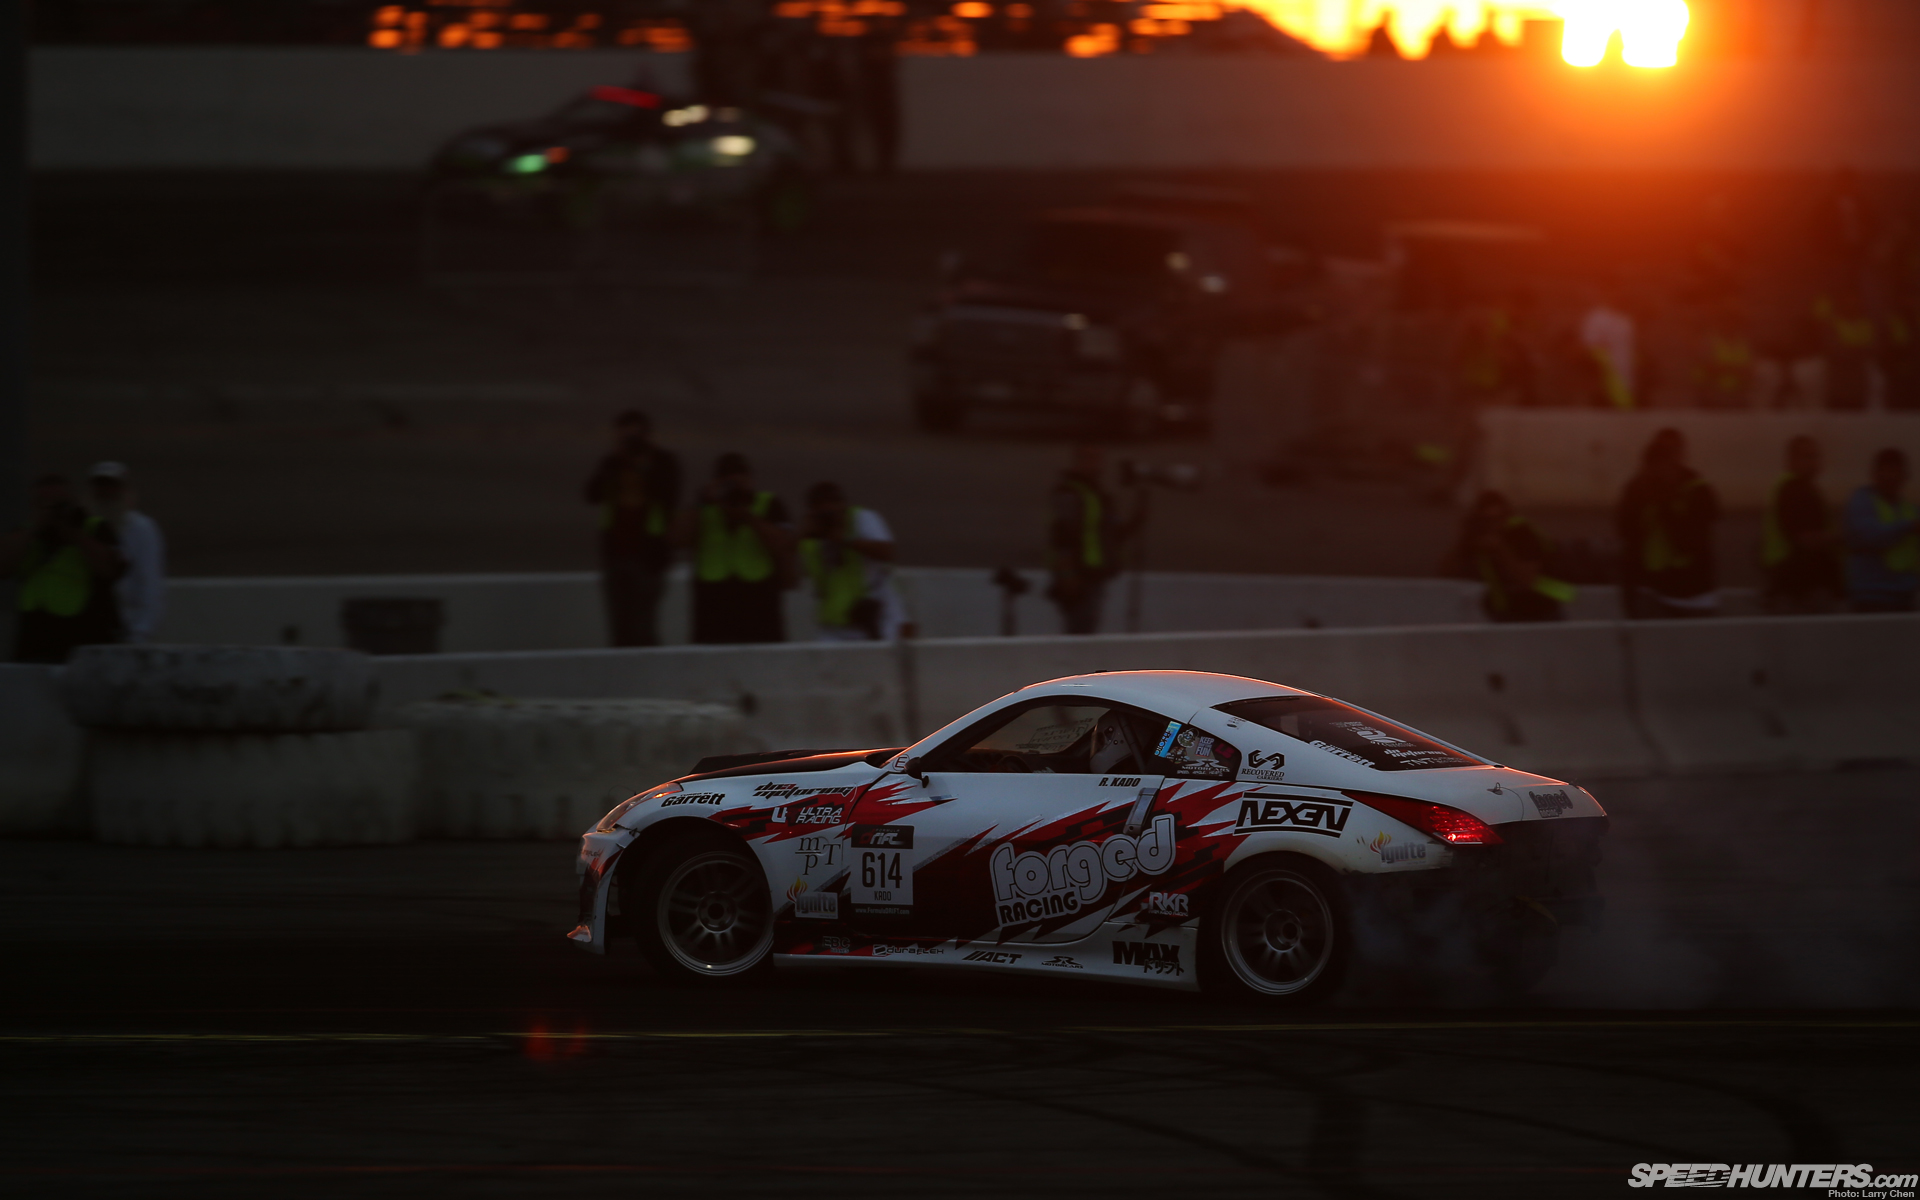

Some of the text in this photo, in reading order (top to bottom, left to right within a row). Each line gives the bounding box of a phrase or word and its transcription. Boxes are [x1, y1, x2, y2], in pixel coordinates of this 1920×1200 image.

[1241, 768, 1285, 778] RECOVERED
[1098, 777, 1141, 787] R. KADO
[661, 793, 725, 807] Garrett
[800, 806, 843, 816] ULTRA
[1236, 800, 1352, 831] NEXEN
[795, 815, 842, 825] RACING
[991, 815, 1175, 902] forged
[862, 851, 902, 889] 614
[873, 890, 892, 902] KADO
[1148, 891, 1189, 912] RKR
[999, 891, 1079, 924] RACING
[822, 935, 851, 950] EBC
[1112, 940, 1181, 967] MAX
